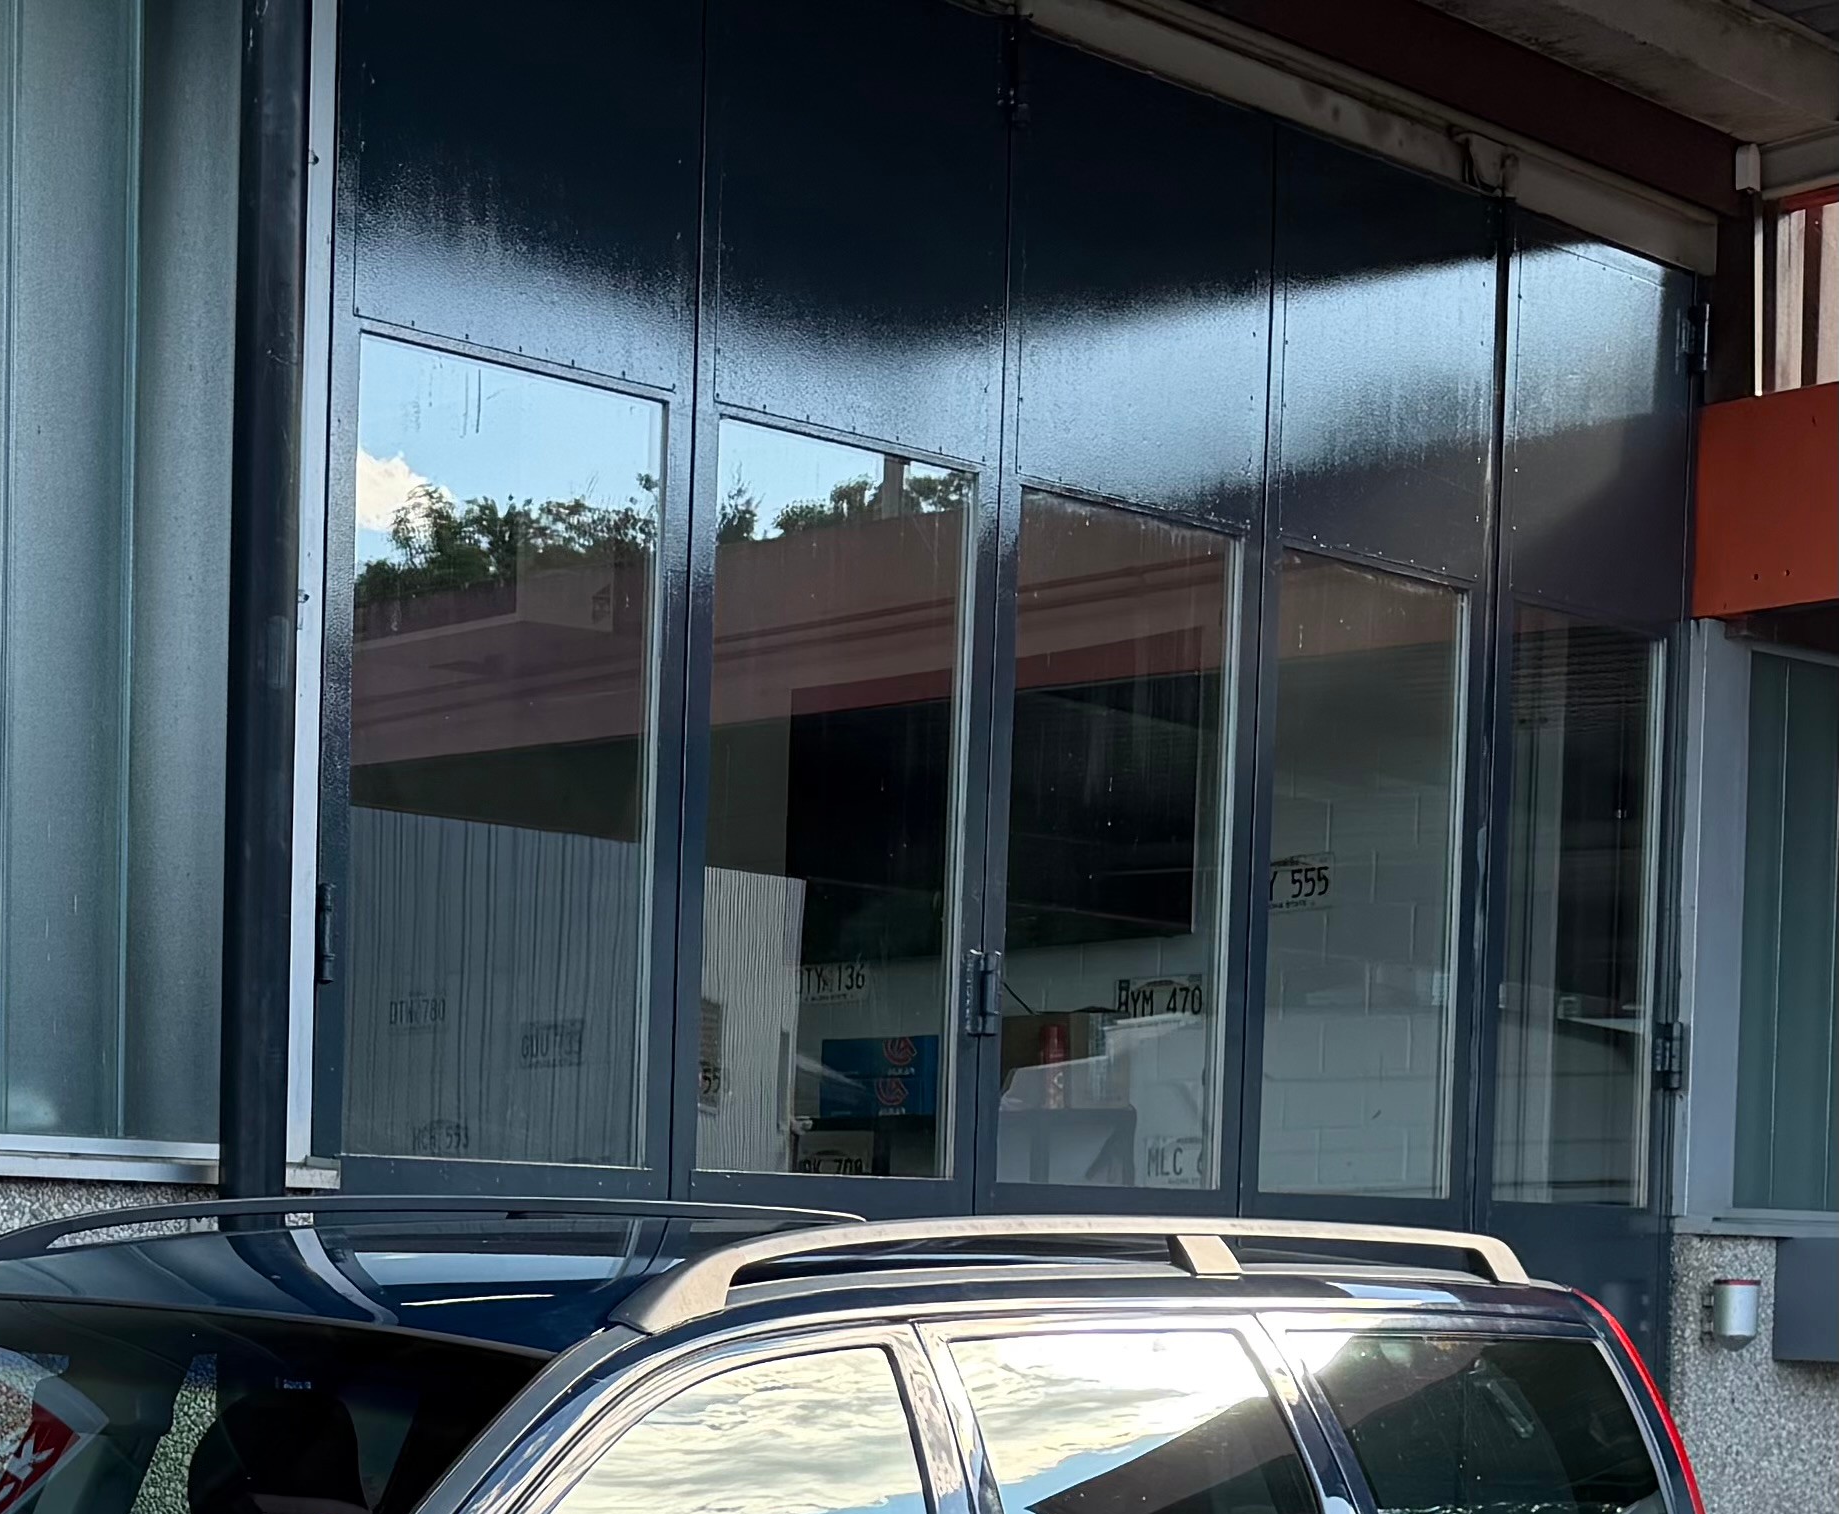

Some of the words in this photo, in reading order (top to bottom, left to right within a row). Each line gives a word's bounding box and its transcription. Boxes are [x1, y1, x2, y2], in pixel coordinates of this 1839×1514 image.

[1291, 866, 1330, 898] 555
[1166, 985, 1202, 1015] 470
[1147, 1147, 1183, 1177] MLC
